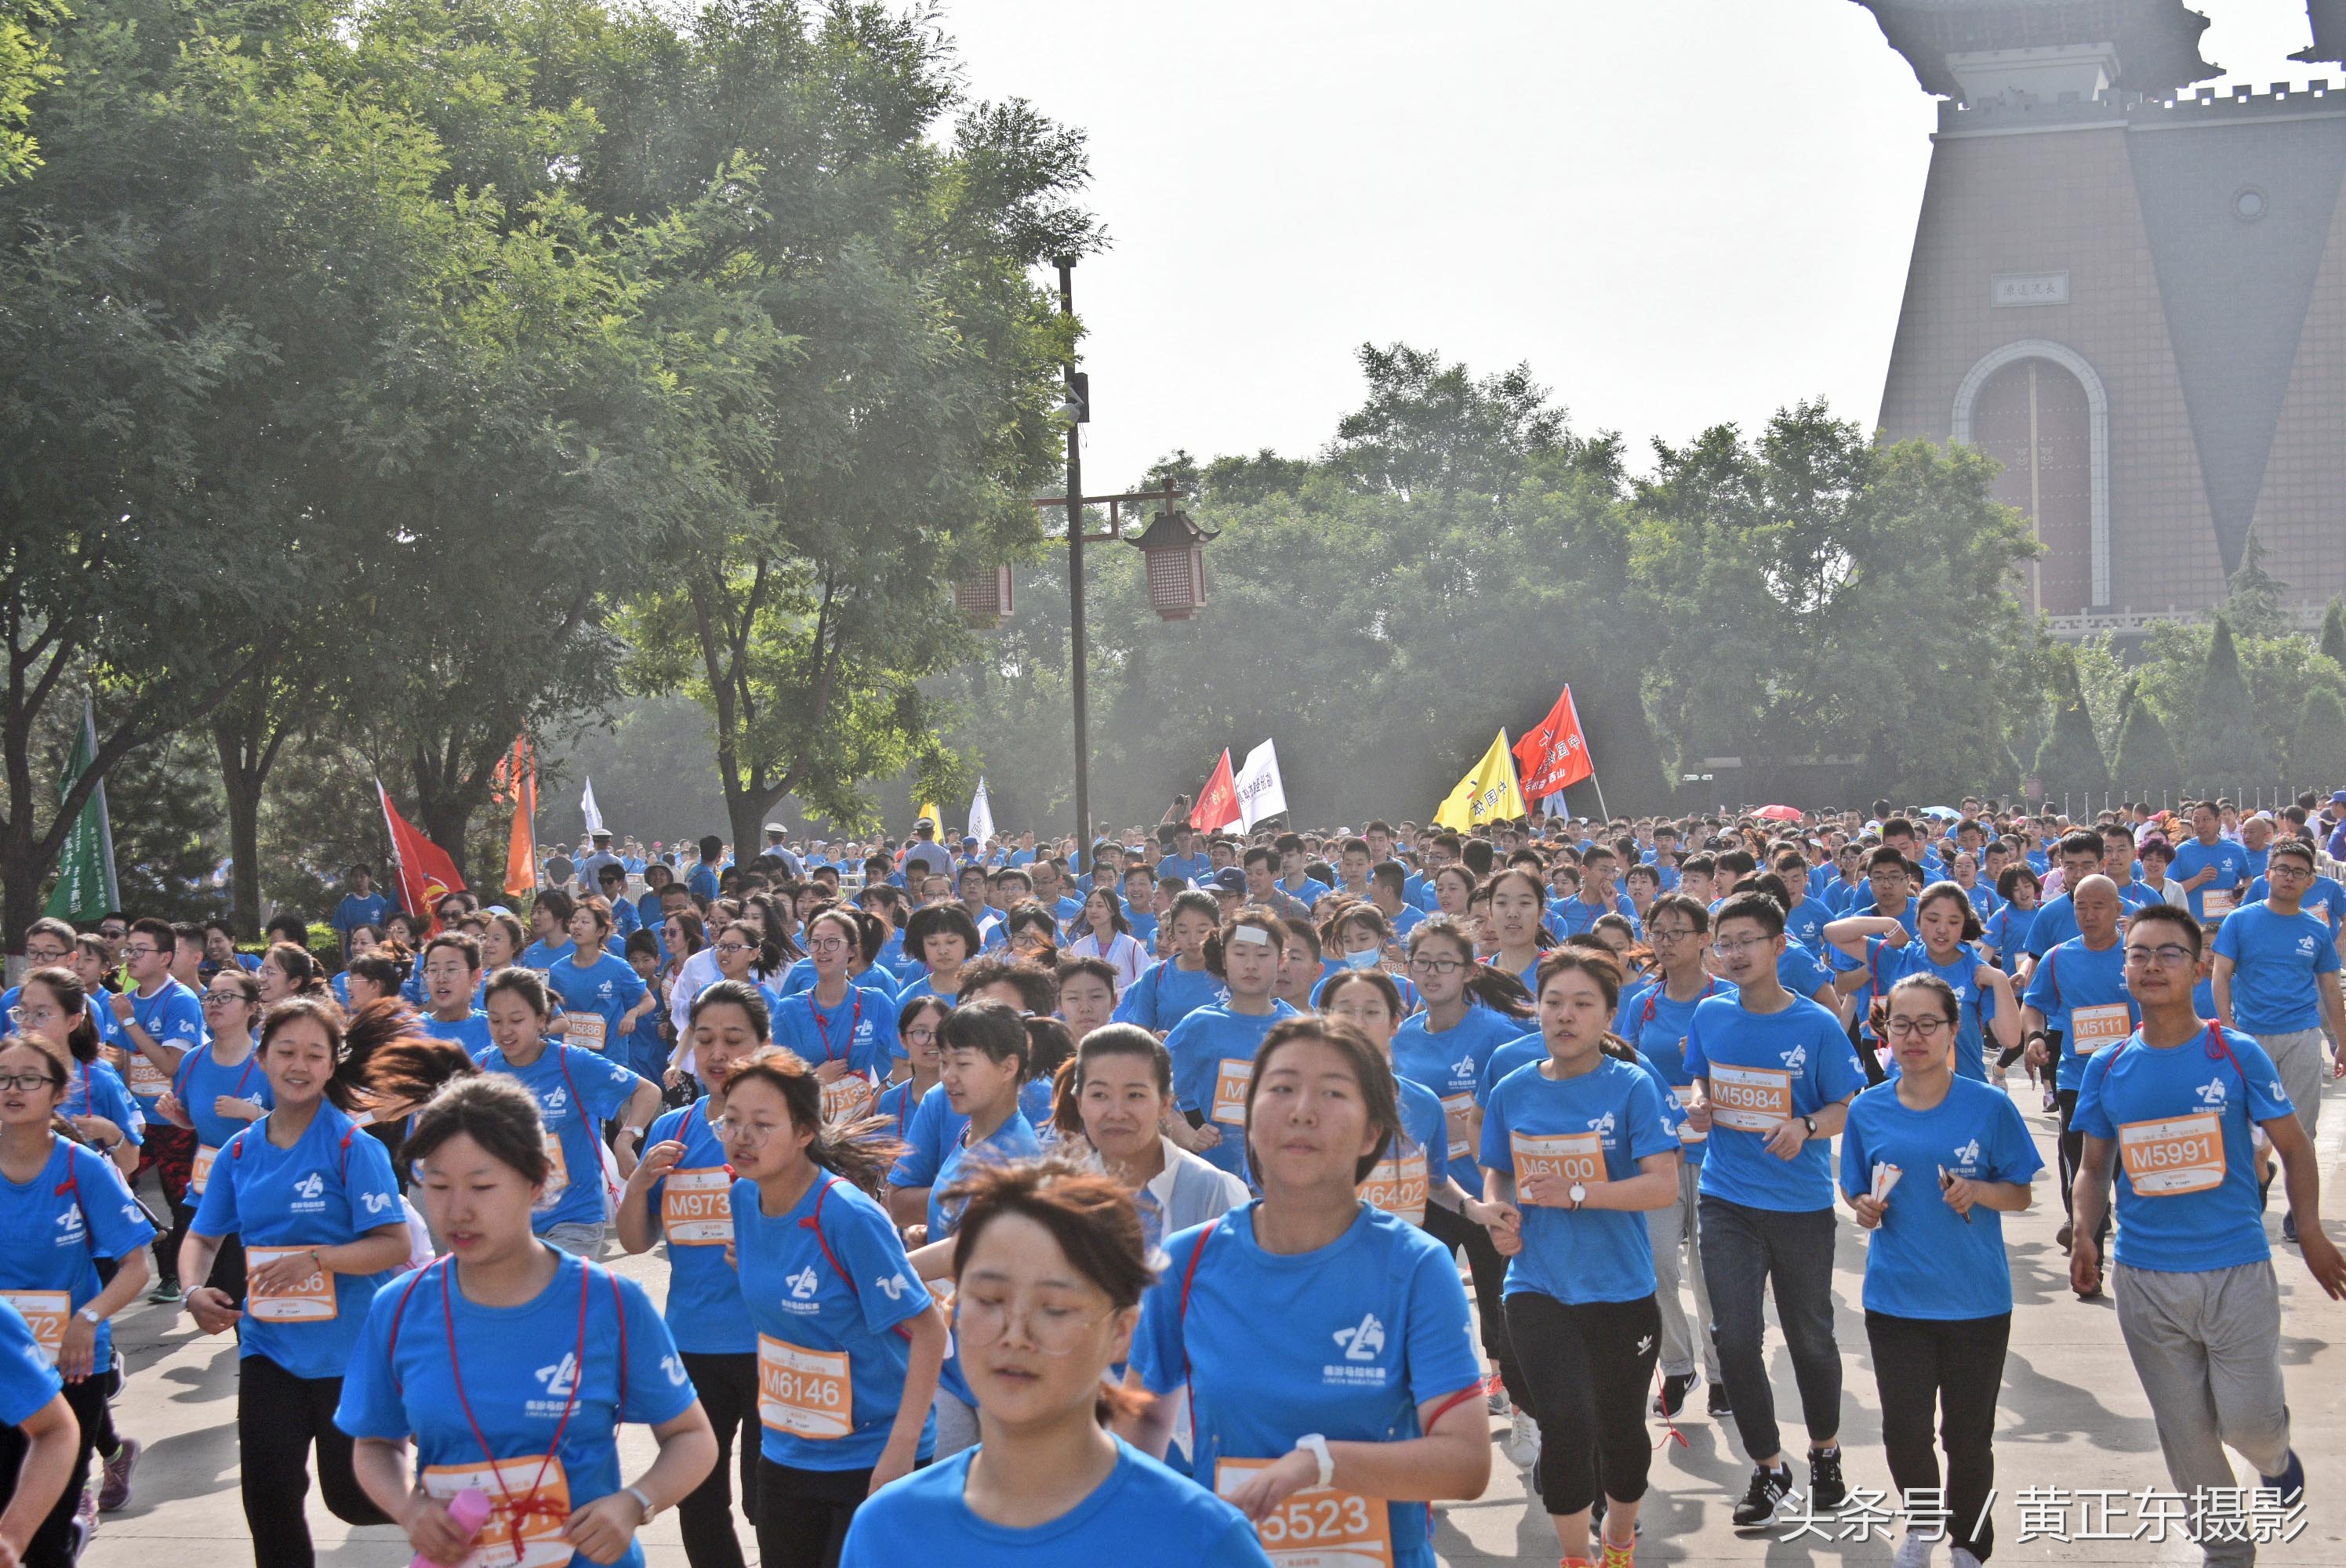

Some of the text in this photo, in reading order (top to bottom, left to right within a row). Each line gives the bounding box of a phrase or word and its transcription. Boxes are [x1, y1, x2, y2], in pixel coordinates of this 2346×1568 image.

[568, 1022, 601, 1036] M5686
[2076, 1018, 2123, 1036] M5111
[1714, 1083, 1781, 1109] M5984
[2130, 1138, 2211, 1169] M5991
[1520, 1156, 1595, 1180] M6100
[764, 1365, 841, 1406] M6146
